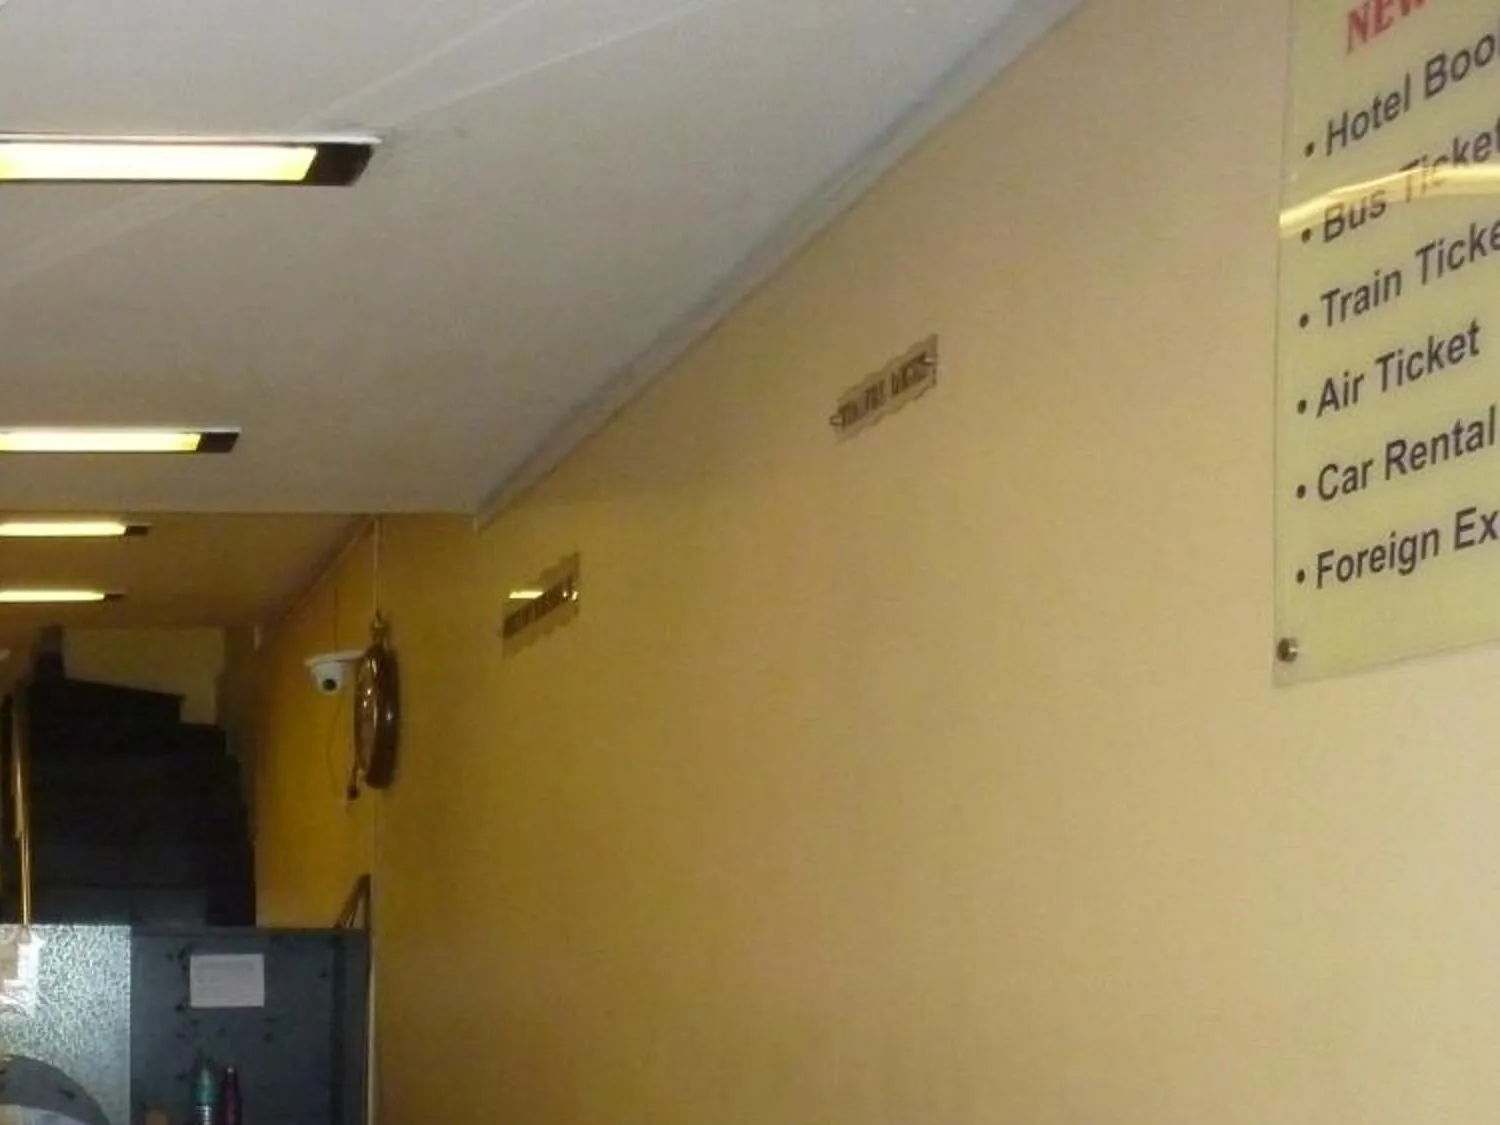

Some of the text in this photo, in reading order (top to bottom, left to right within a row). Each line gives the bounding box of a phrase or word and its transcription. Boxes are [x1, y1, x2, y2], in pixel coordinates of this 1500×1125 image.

[1325, 16, 1500, 157] Hotel Boo
[1323, 189, 1387, 243] Bus
[1320, 269, 1402, 327] Train
[1316, 317, 1480, 418] Air Ticket
[1317, 405, 1496, 501] Car Rental
[1316, 527, 1440, 588] Foreign
